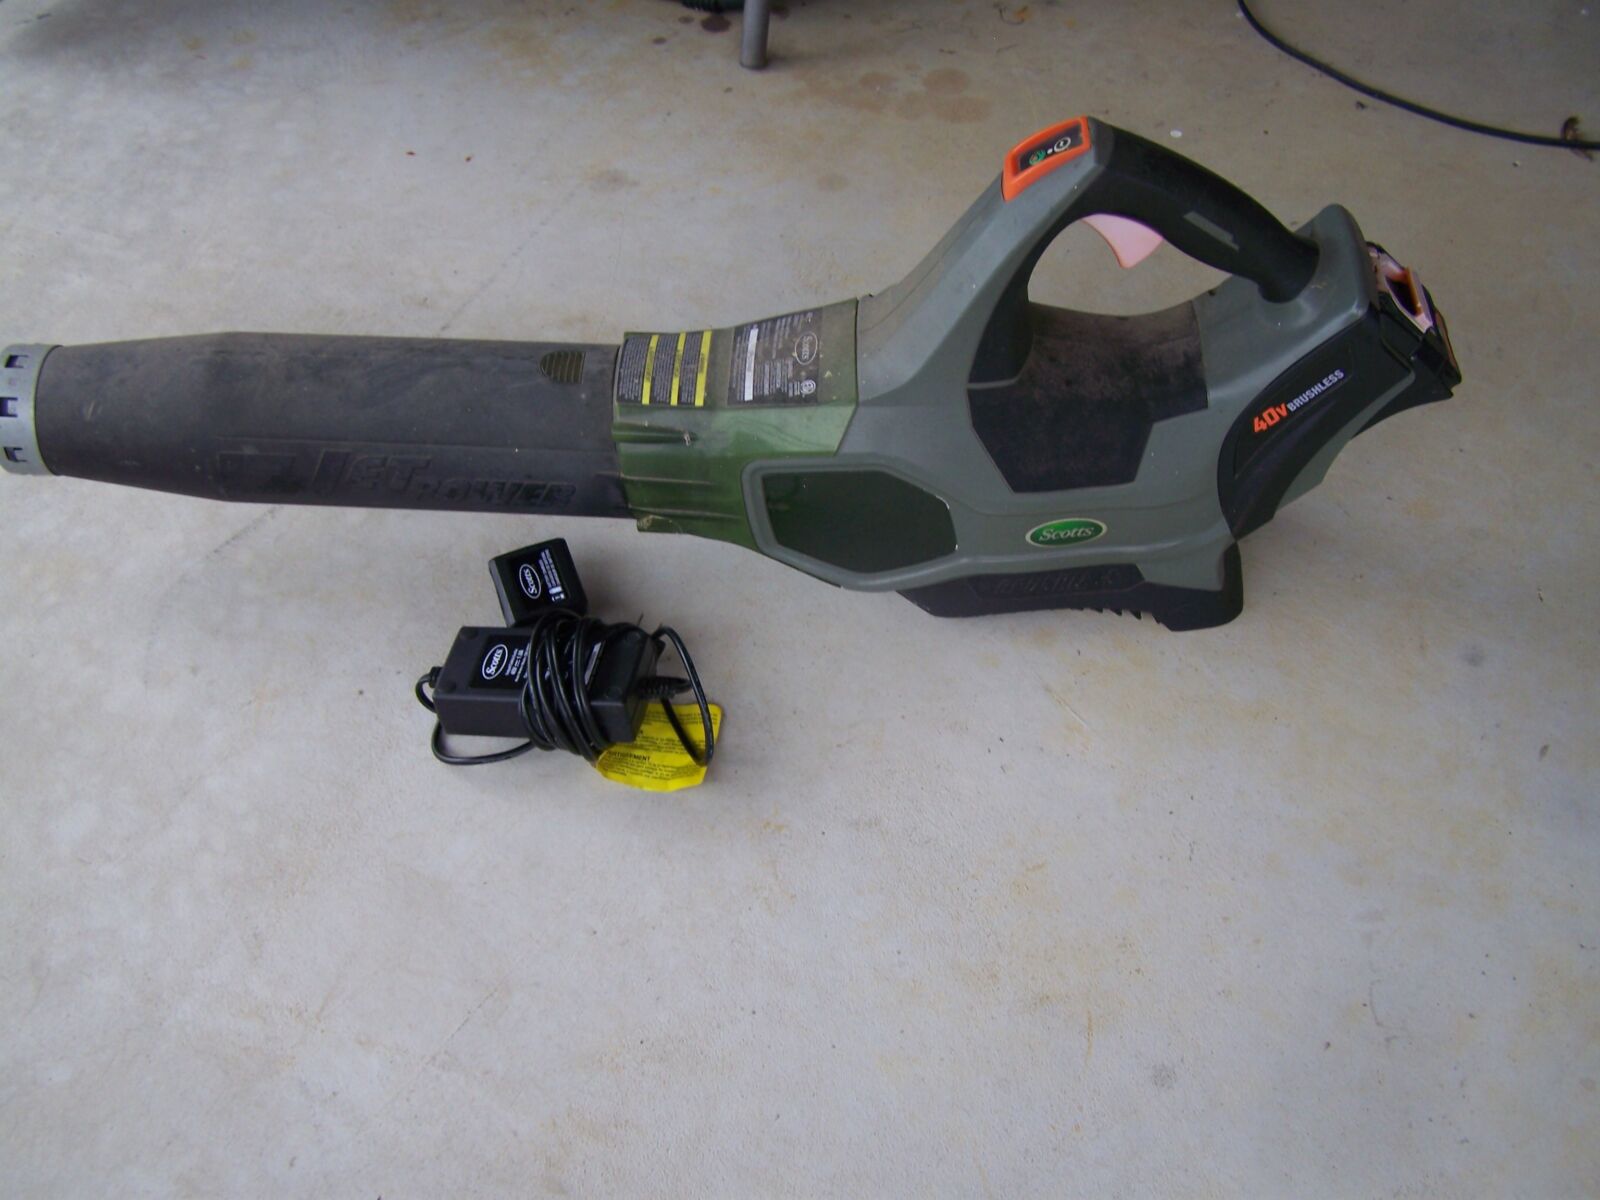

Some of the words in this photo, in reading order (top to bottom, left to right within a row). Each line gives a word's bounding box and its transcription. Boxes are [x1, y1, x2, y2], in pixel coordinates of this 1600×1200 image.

[1287, 369, 1345, 412] BRUSHLESS
[413, 477, 577, 507] POWER
[1039, 527, 1095, 541] Scotts
[486, 649, 503, 675] Scotts
